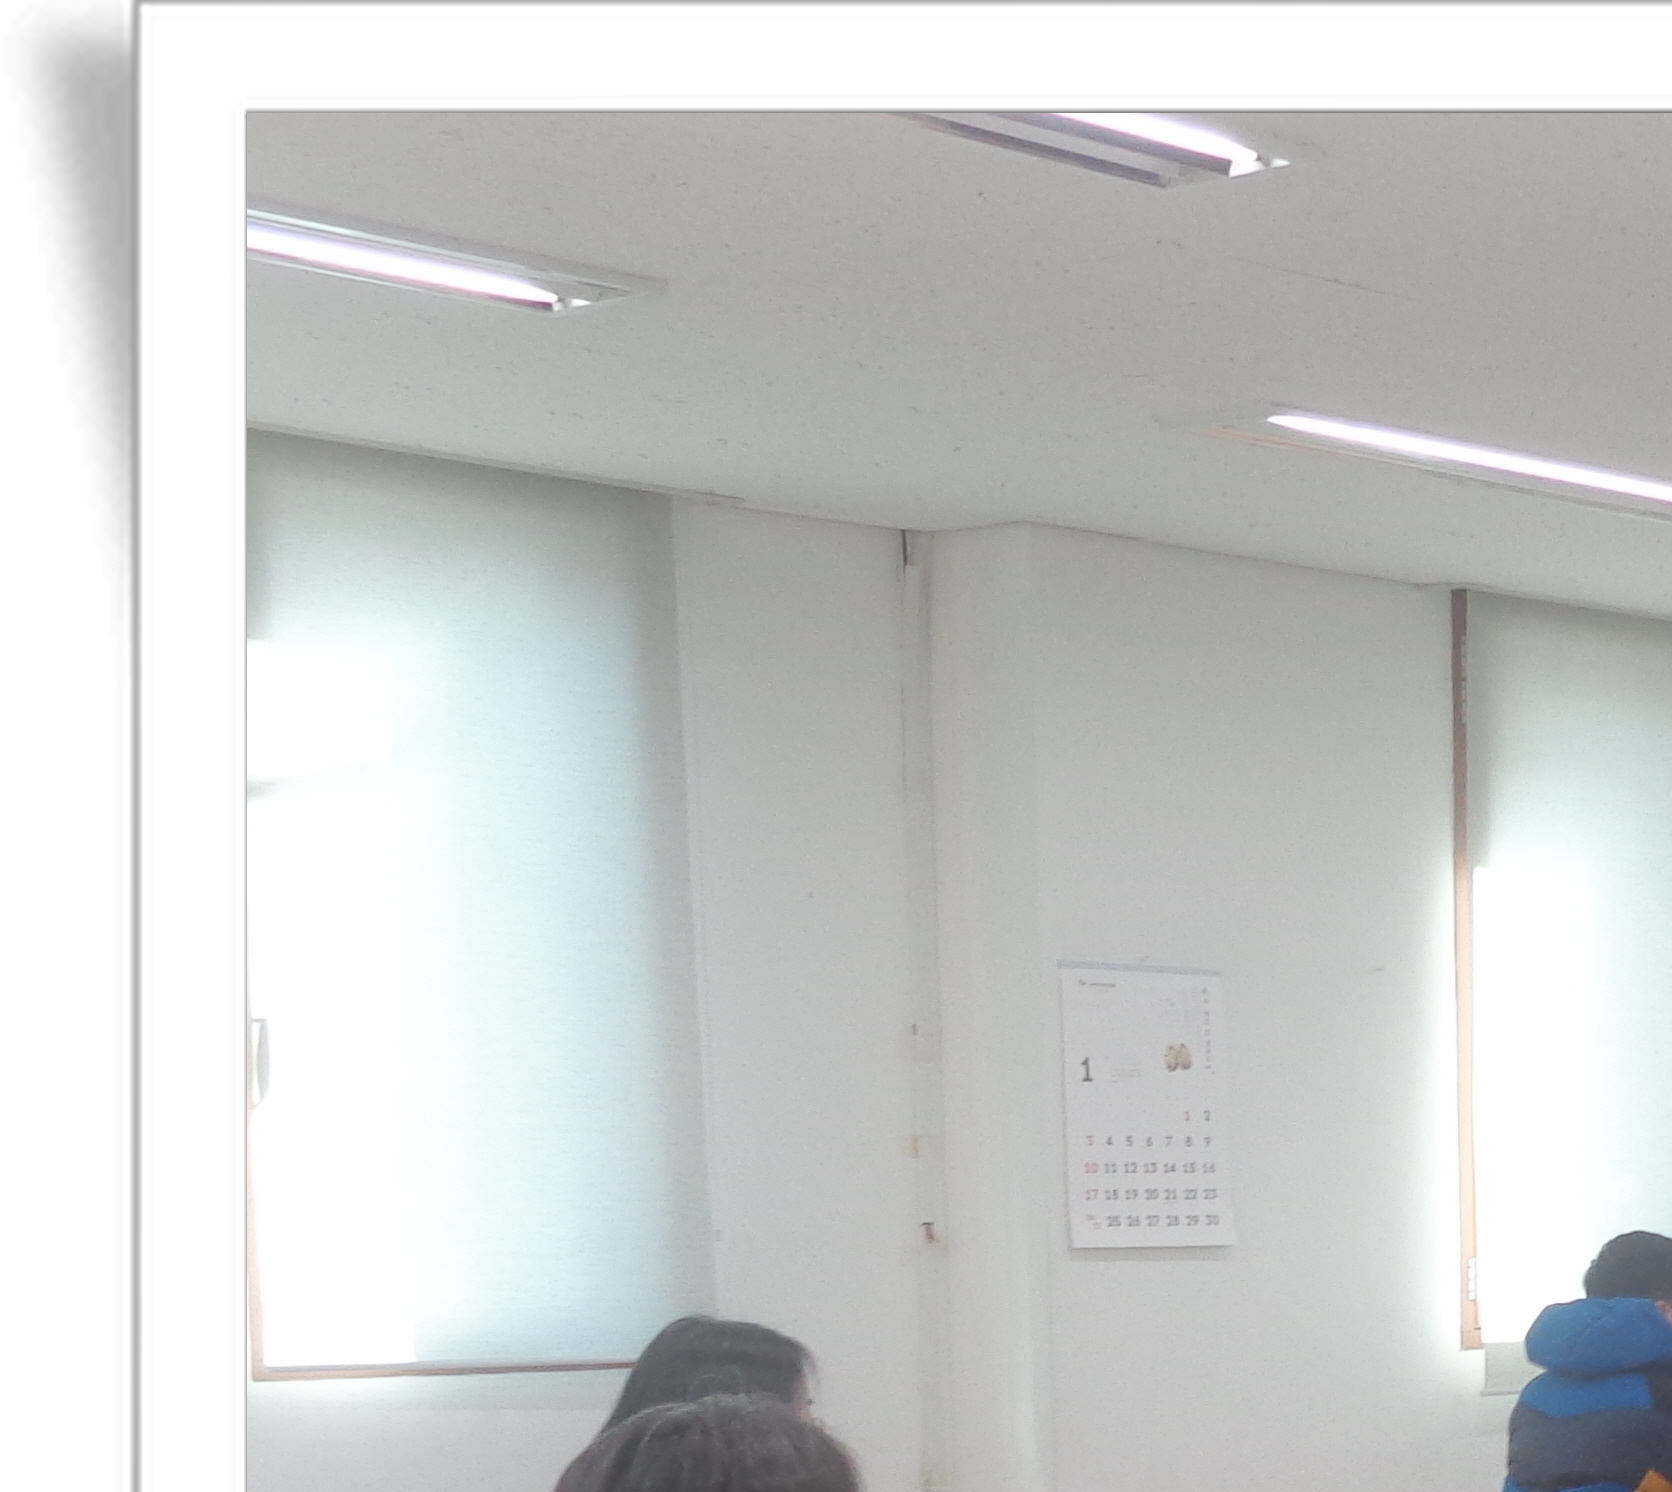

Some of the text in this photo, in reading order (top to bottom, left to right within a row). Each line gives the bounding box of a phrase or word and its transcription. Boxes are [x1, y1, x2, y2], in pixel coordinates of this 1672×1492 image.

[1080, 1056, 1094, 1083] 1
[1203, 1110, 1211, 1122] 2
[1106, 1135, 1113, 1147] 4
[1126, 1135, 1133, 1147] 5
[1146, 1135, 1153, 1147] 6
[1165, 1135, 1173, 1147] 7
[1124, 1162, 1138, 1174] 12
